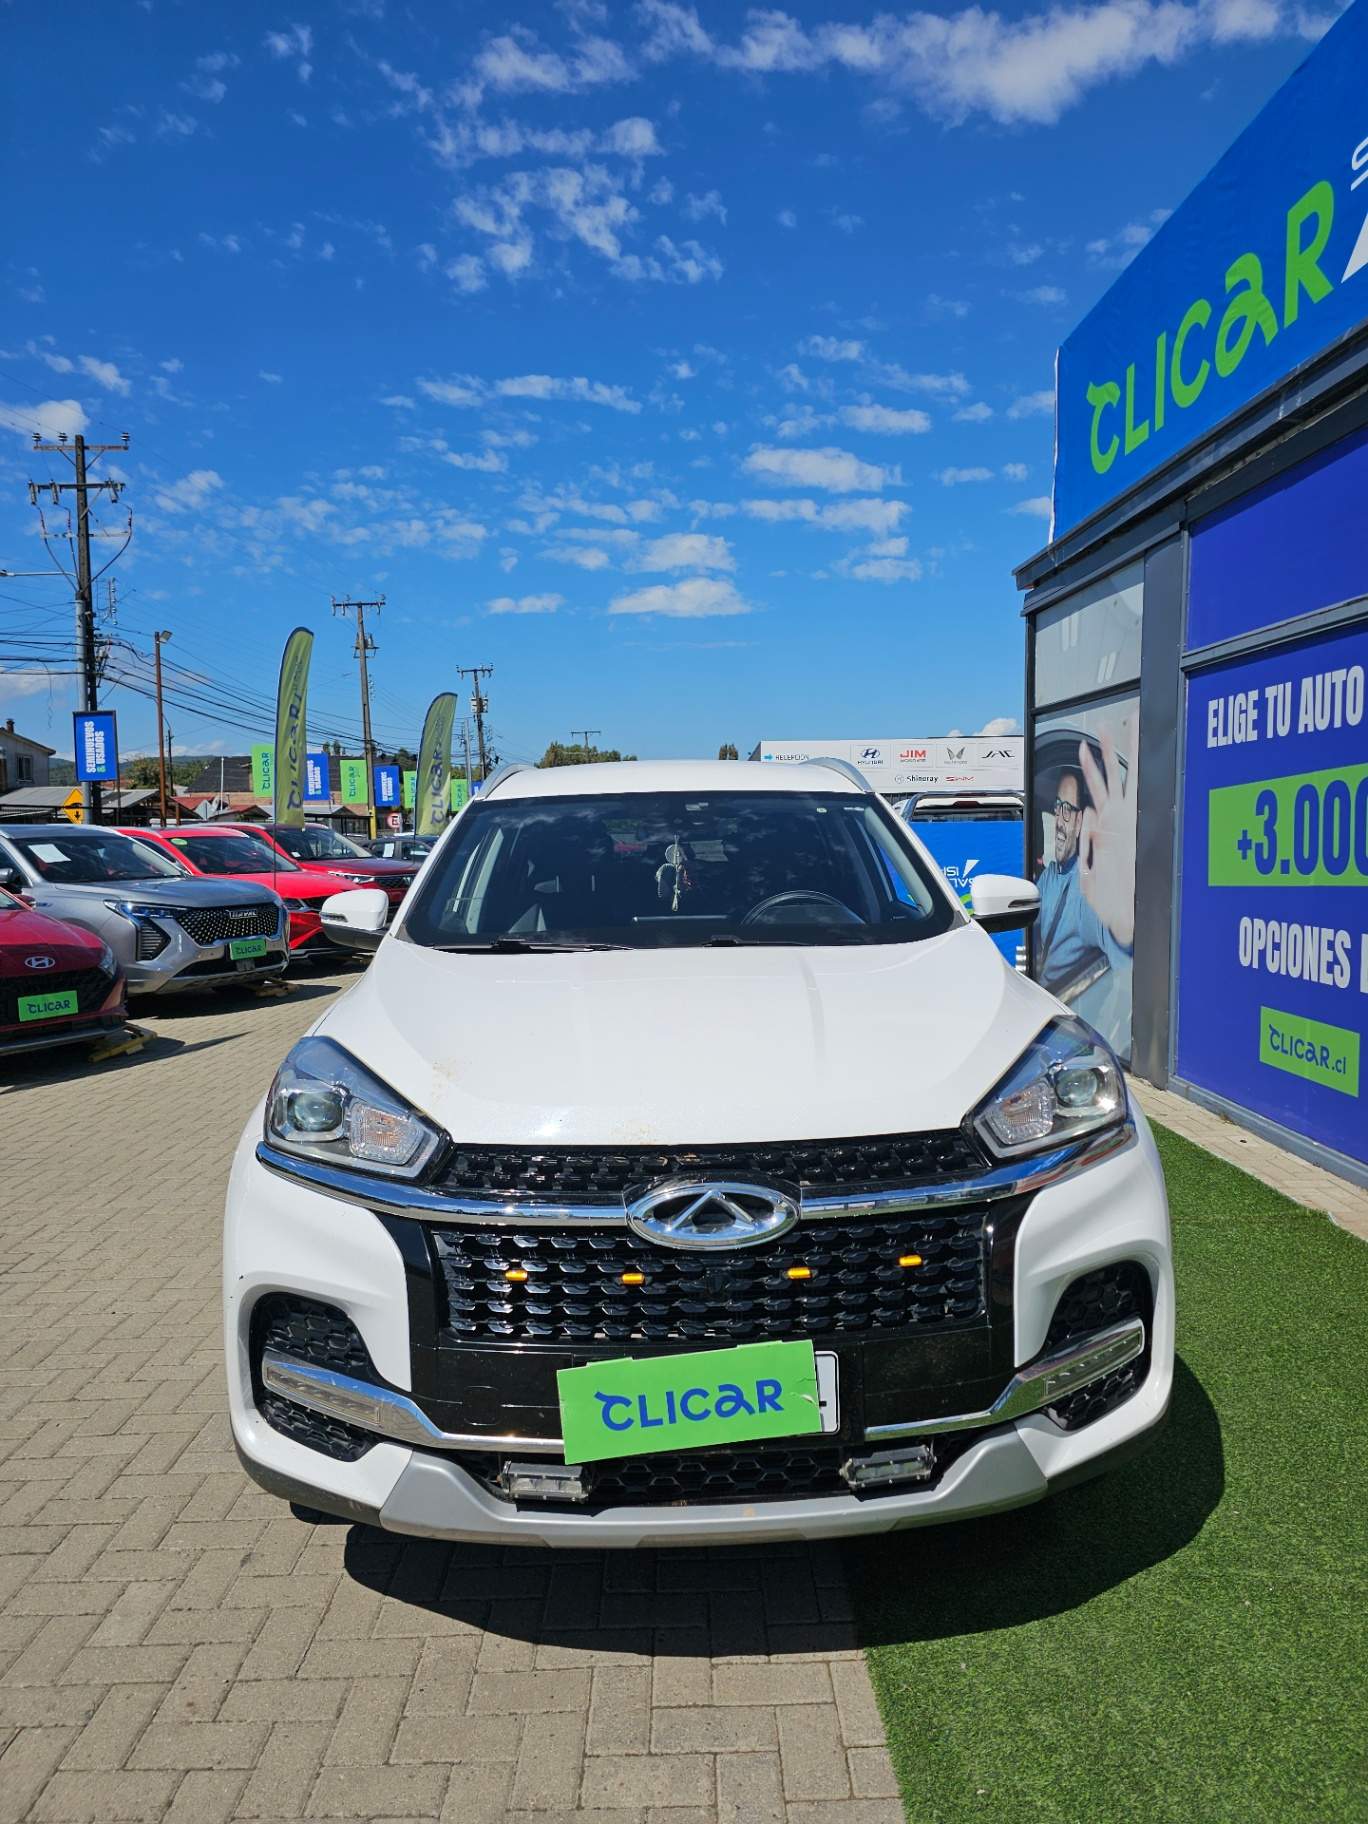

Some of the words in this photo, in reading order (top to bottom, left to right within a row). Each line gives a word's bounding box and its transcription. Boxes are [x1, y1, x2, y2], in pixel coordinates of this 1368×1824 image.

[1208, 690, 1259, 748] ELIGE
[1265, 682, 1292, 738] TU
[1298, 666, 1365, 734] AUTO
[900, 749, 926, 758] JIM
[1239, 916, 1351, 989] OPCIONES
